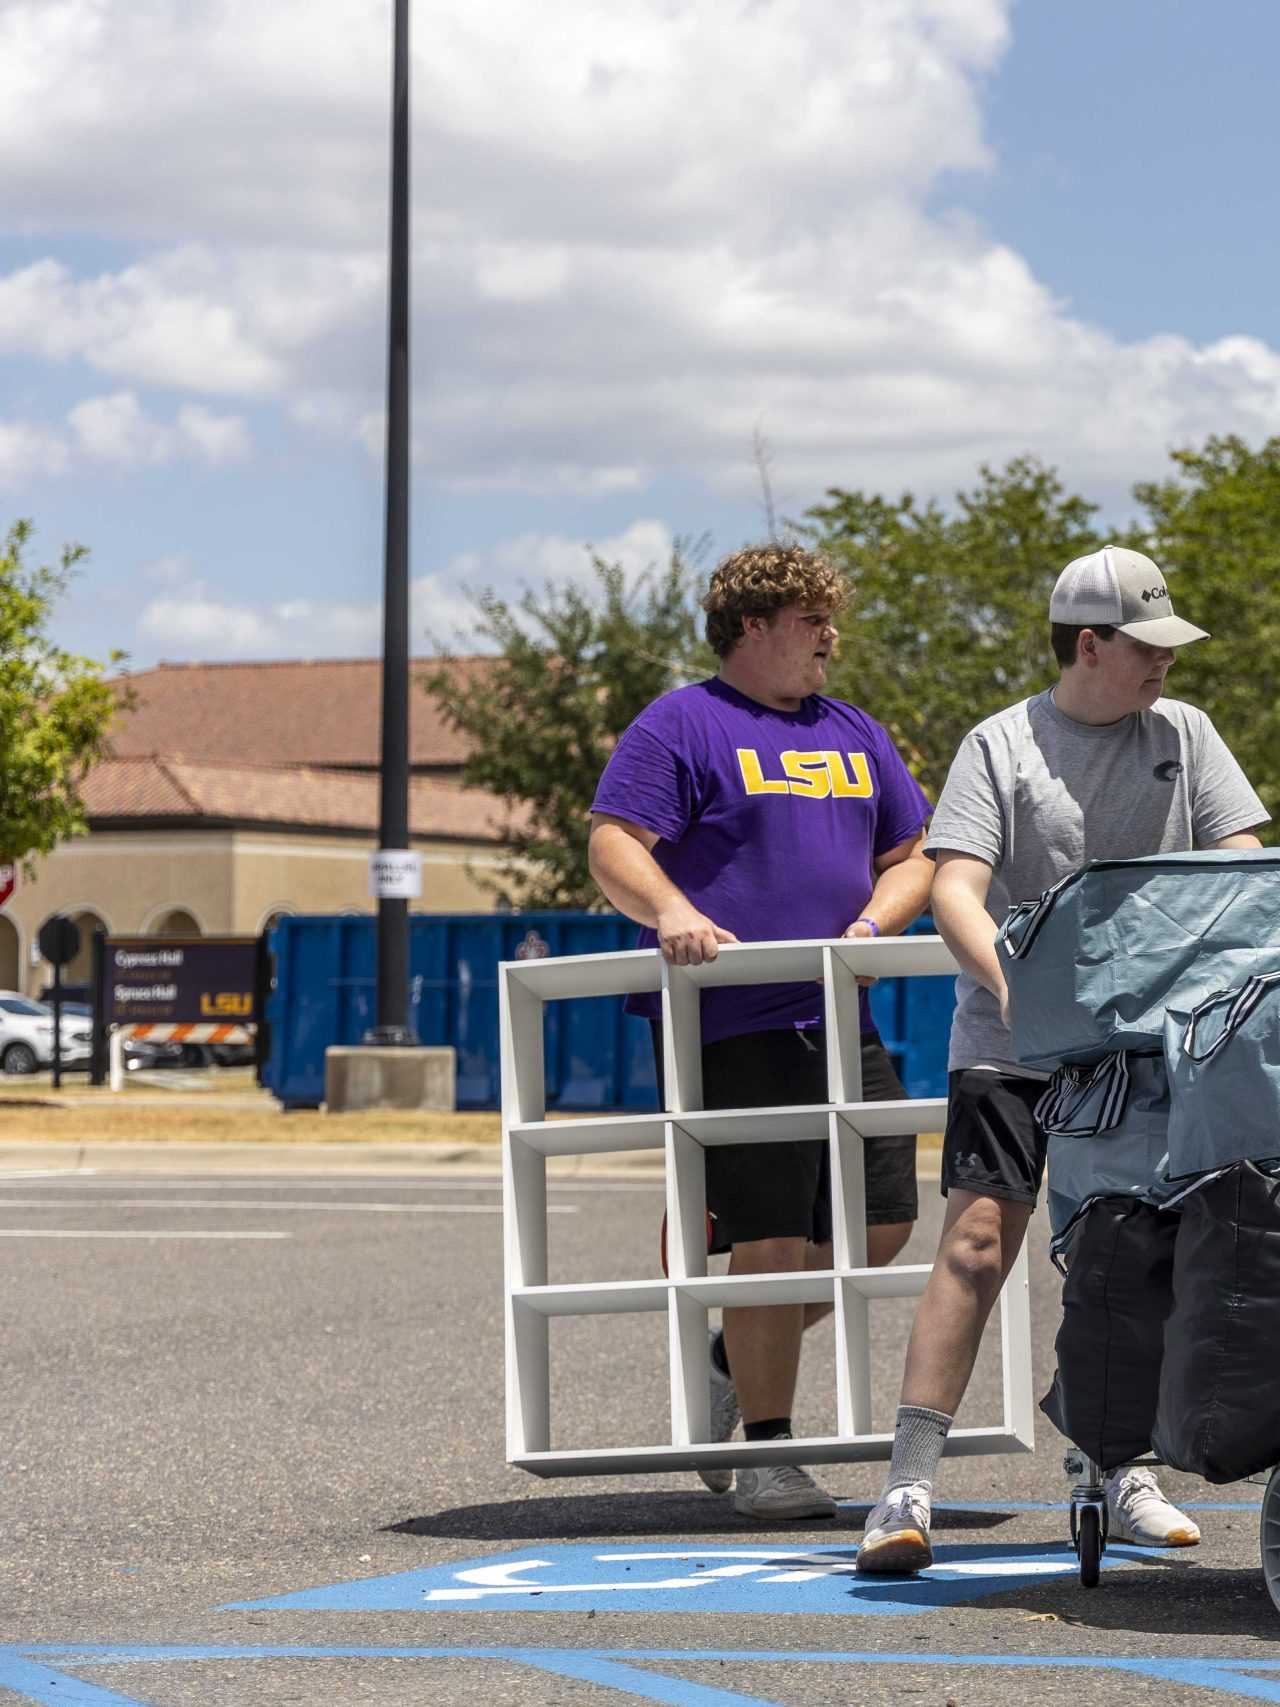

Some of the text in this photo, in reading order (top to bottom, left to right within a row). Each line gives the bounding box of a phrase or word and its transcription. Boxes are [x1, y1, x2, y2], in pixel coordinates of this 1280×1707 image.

[736, 748, 874, 799] LSU
[158, 950, 183, 966] Hall
[152, 984, 176, 1000] Hall
[201, 992, 253, 1016] LSU
